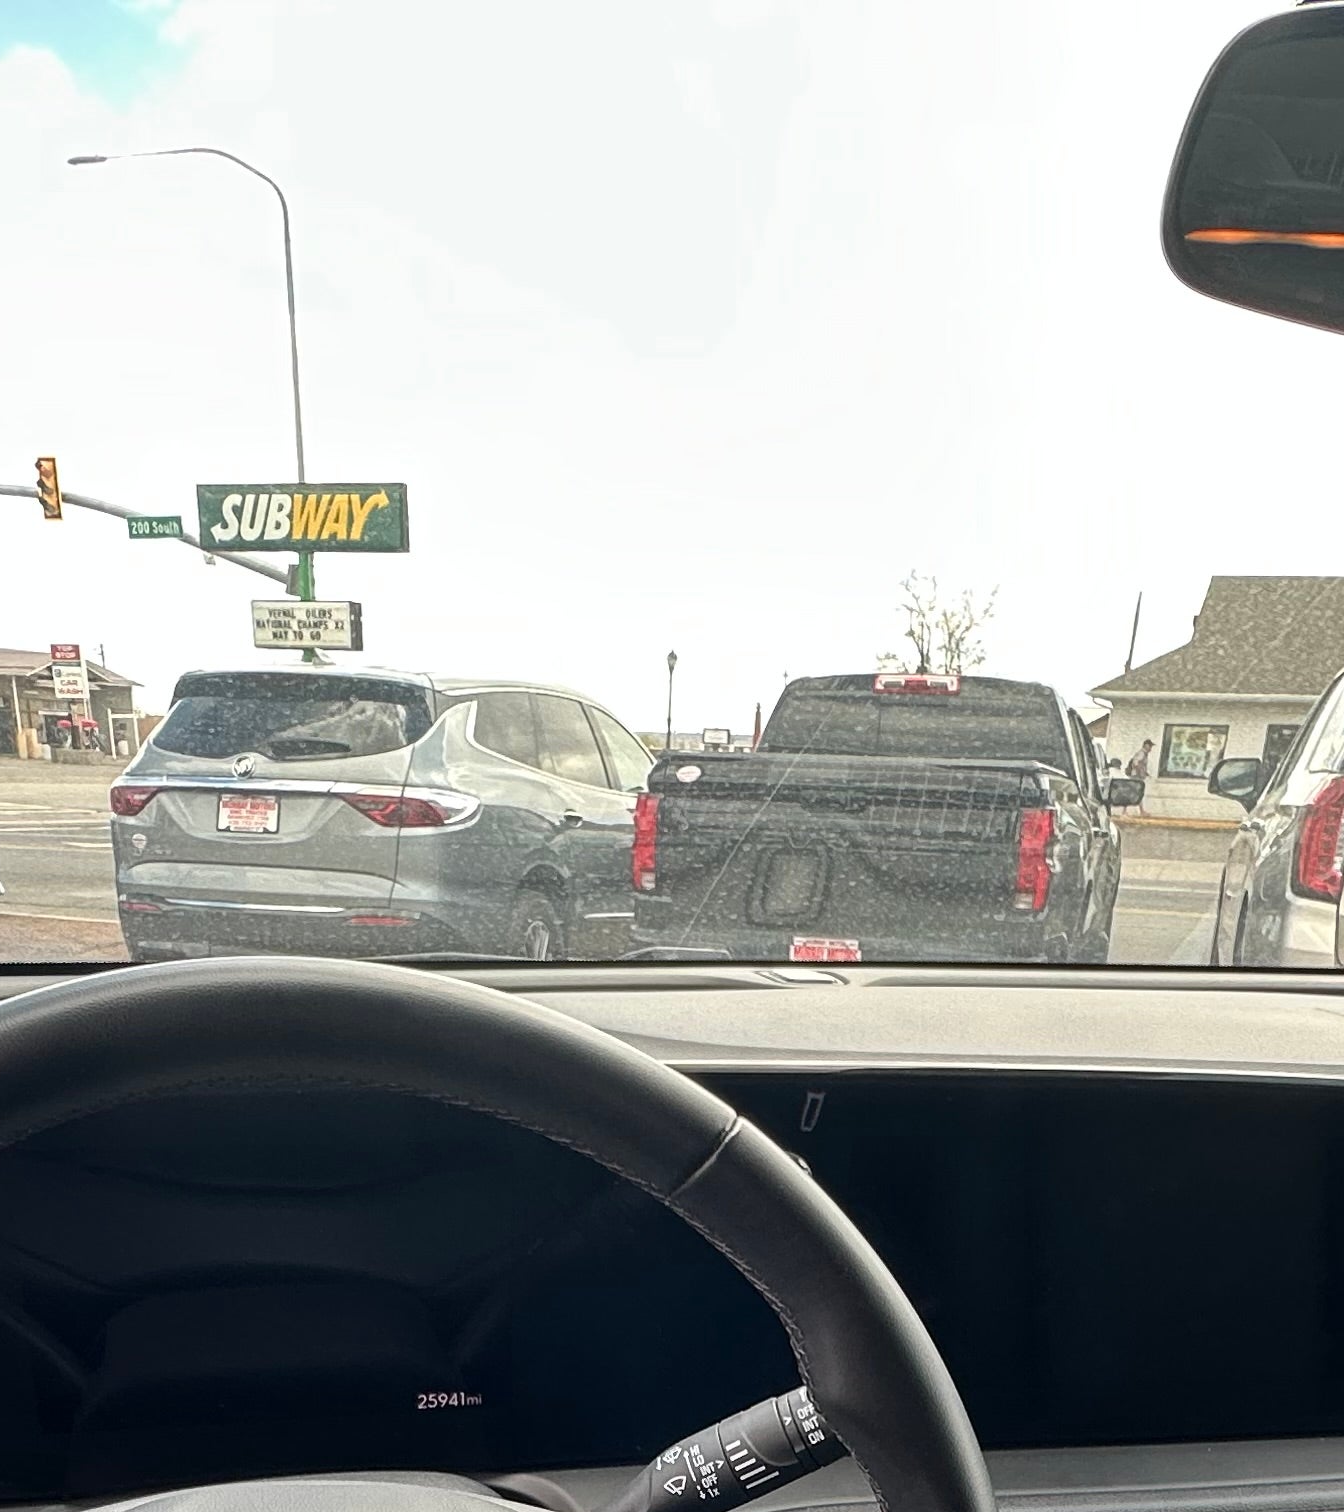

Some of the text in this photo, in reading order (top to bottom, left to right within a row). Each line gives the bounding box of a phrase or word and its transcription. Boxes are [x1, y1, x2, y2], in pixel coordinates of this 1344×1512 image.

[209, 489, 390, 544] SUBWAY
[131, 521, 180, 535] 200 South
[293, 631, 304, 641] TO
[797, 1404, 816, 1420] OFF
[802, 1416, 820, 1433] INT
[807, 1429, 825, 1445] ON
[692, 1456, 705, 1468] LO
[699, 1461, 715, 1477] INT
[701, 1474, 718, 1489] OFF
